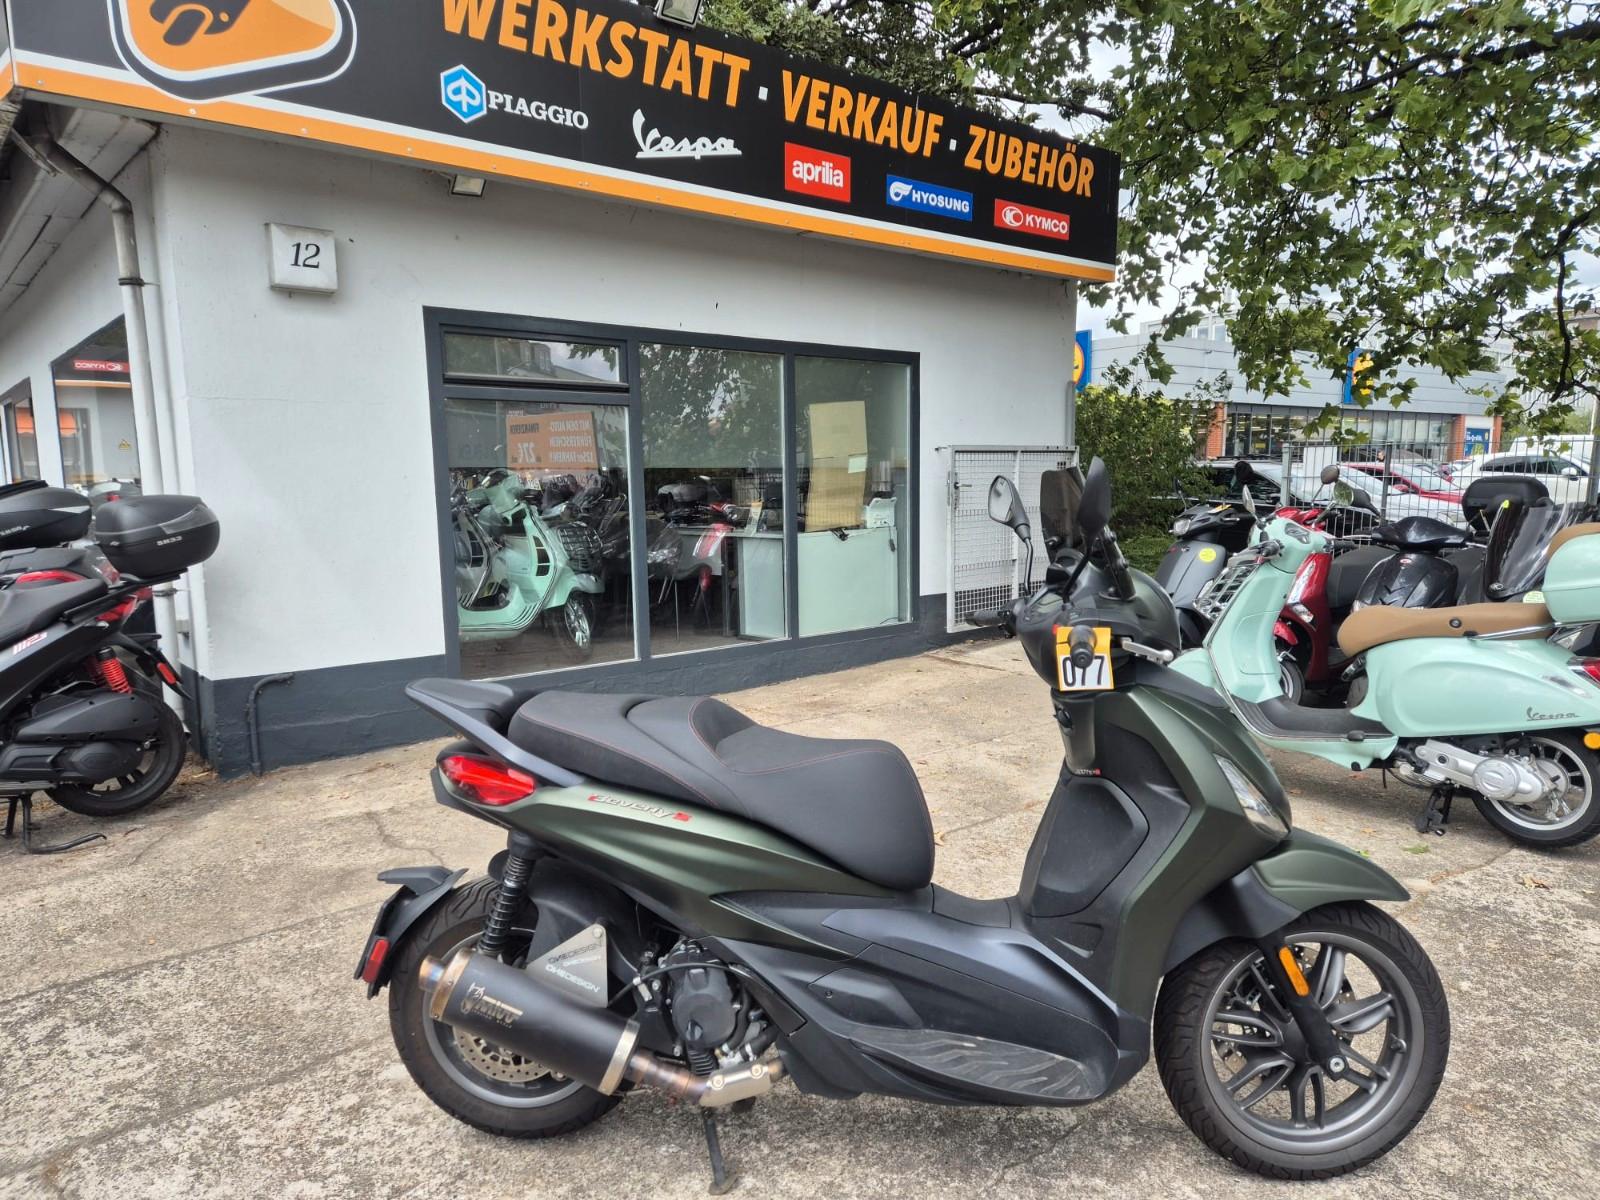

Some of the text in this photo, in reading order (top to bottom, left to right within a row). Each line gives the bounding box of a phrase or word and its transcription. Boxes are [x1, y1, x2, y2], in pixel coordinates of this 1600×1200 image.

[441, 0, 1095, 198] WERKSTATT VERKAUF ZUBEHÖR
[487, 90, 590, 130] PIAGGIO
[632, 108, 743, 160] Vespa
[791, 158, 844, 189] aprilia
[911, 188, 971, 214] HYOSUNG
[1025, 213, 1069, 235] KYMCO
[290, 241, 321, 269] 12
[593, 795, 674, 818] Beverly
